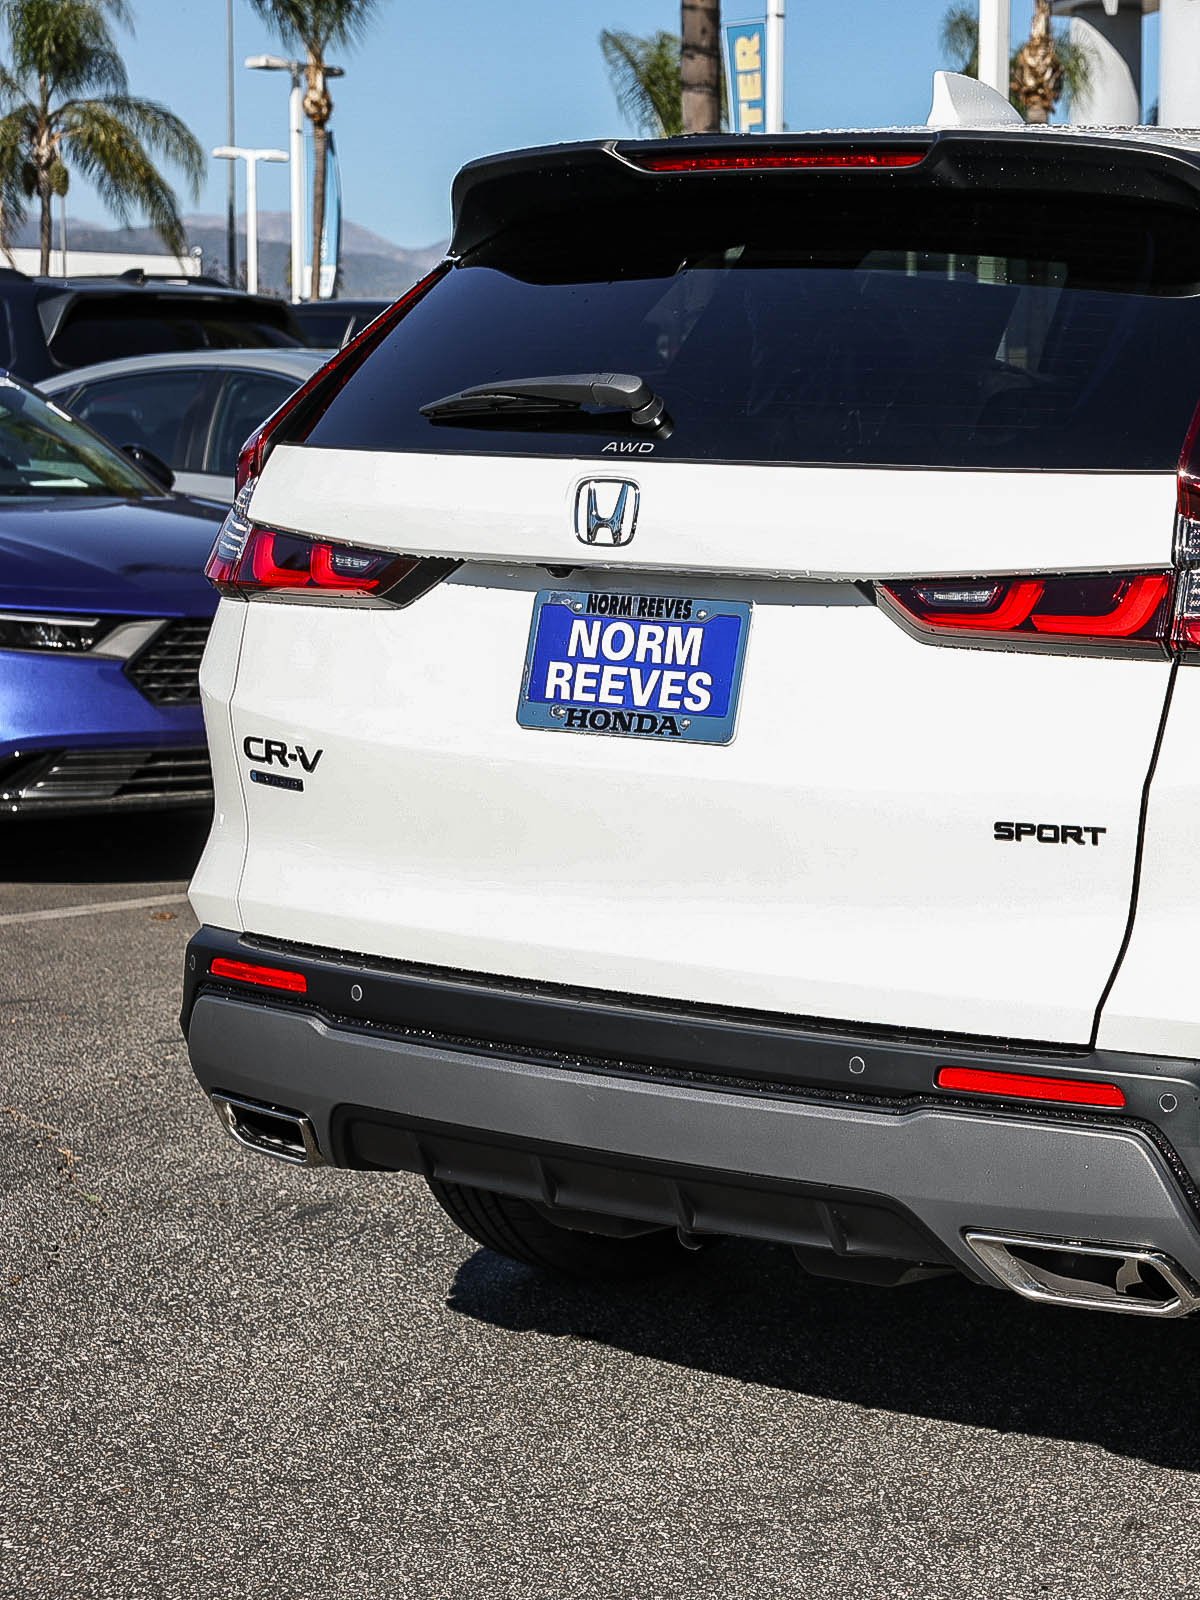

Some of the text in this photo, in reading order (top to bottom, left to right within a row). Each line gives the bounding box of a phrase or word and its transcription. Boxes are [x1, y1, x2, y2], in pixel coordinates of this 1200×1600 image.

[601, 441, 655, 453] AWD
[586, 593, 693, 620] NORM REEVES
[567, 619, 704, 666] NORM
[544, 660, 713, 712] REEVES
[564, 708, 682, 737] HONDA
[243, 735, 324, 774] CR-V
[993, 821, 1107, 846] SPORT
